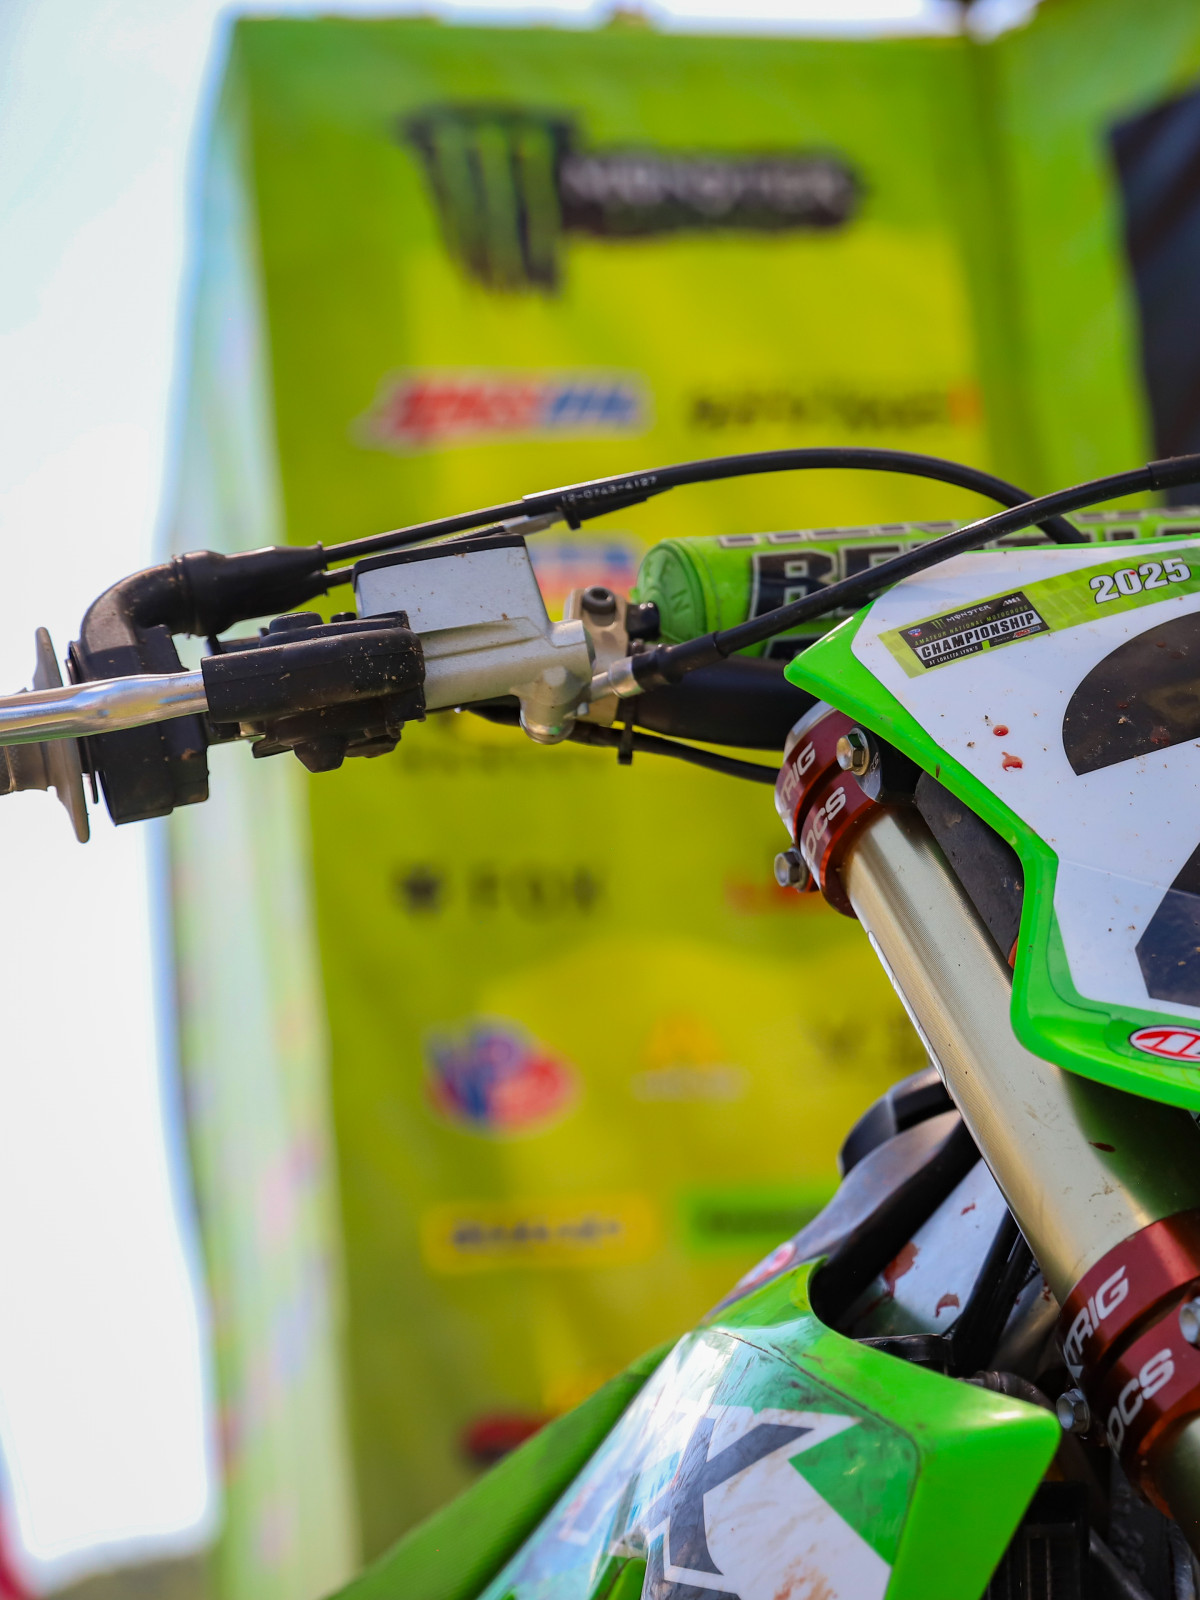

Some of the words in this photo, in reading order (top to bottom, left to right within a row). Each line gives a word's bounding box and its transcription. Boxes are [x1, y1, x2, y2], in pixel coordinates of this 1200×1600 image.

[1089, 557, 1192, 605] 2025
[914, 630, 948, 646] AMATEUR
[949, 618, 984, 634] NATIONAL
[986, 604, 1029, 622] MOTOCROSS
[921, 612, 1036, 659] CHAMPIONSHIP
[937, 651, 959, 664] LORETTA
